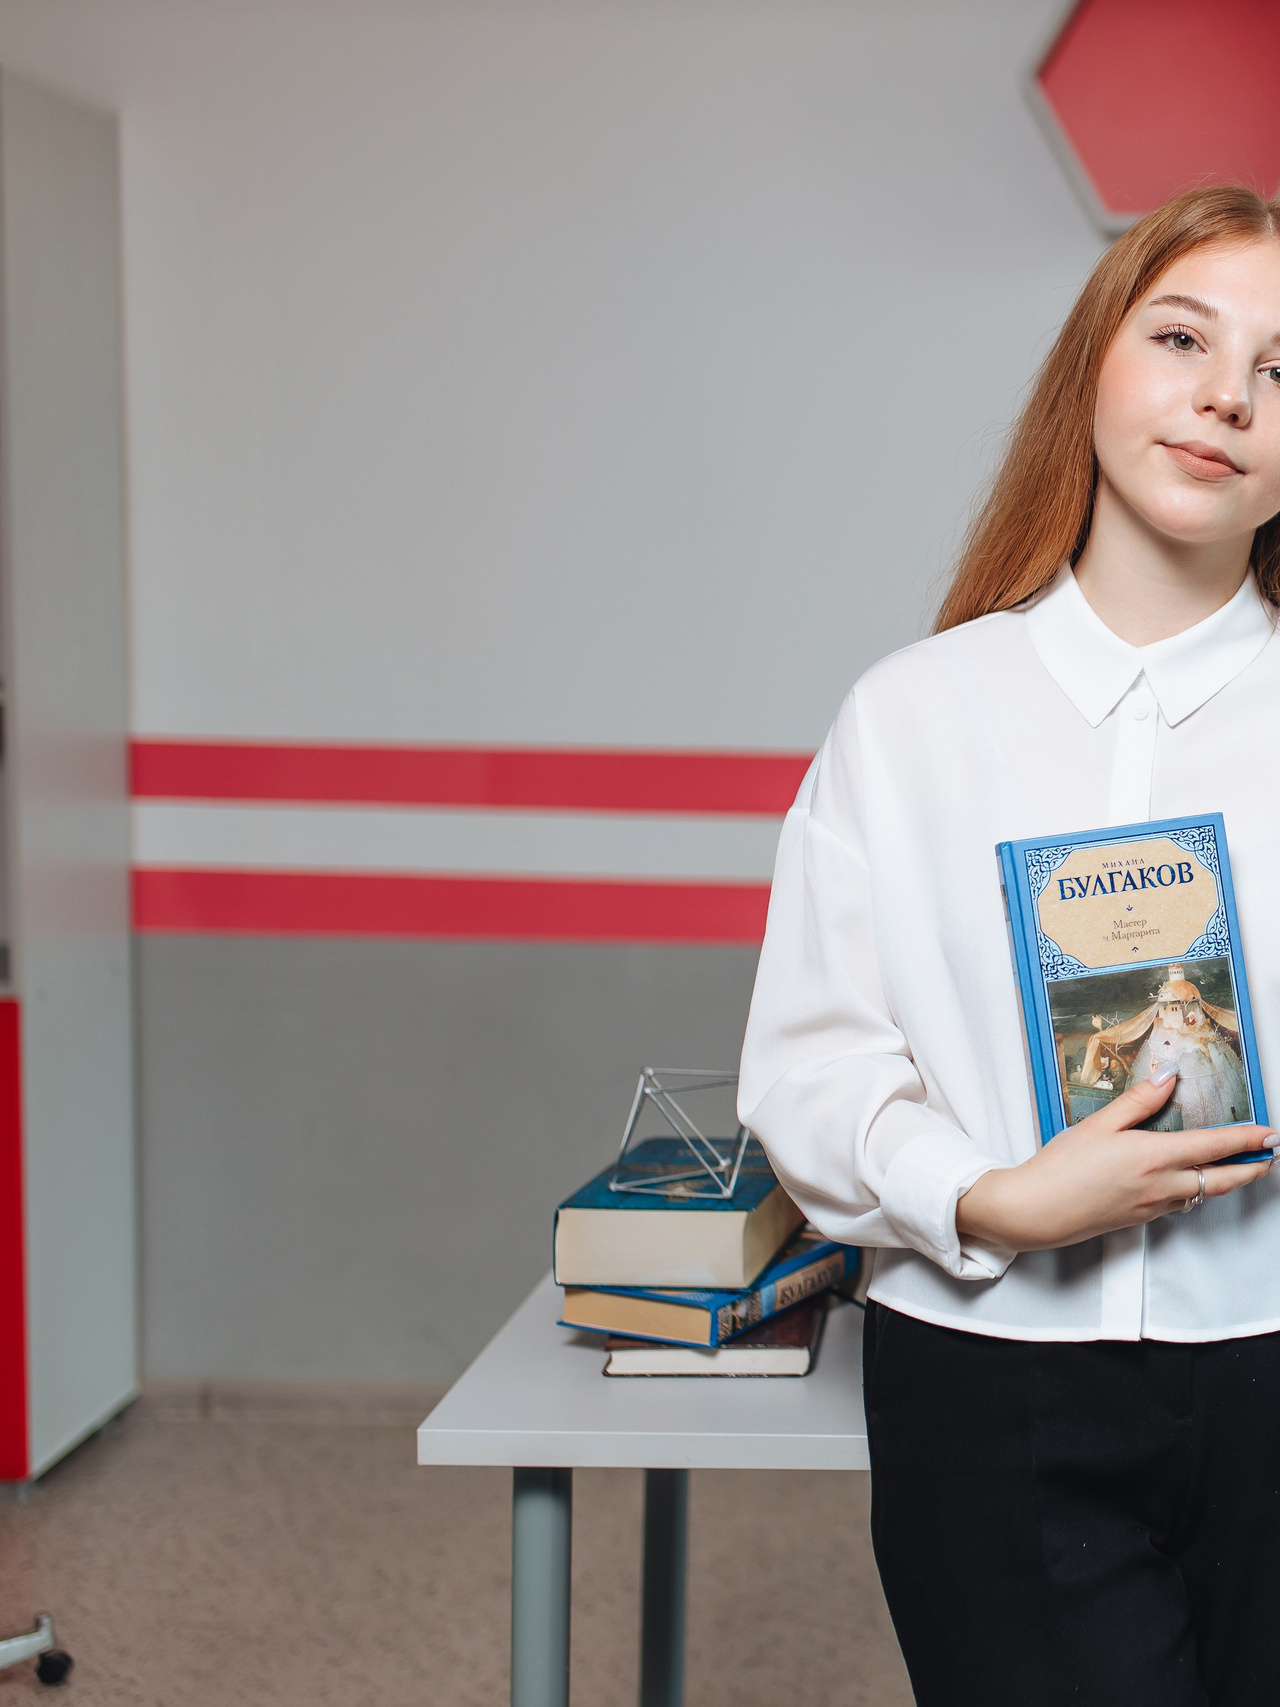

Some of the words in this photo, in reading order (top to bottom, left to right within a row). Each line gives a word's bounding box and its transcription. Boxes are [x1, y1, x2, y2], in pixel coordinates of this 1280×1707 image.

[1102, 858, 1145, 869] МИХАИЛ
[1057, 862, 1194, 901] БУЛГАКОВ
[1113, 919, 1148, 930] Мастер
[1111, 928, 1161, 941] Маргарита
